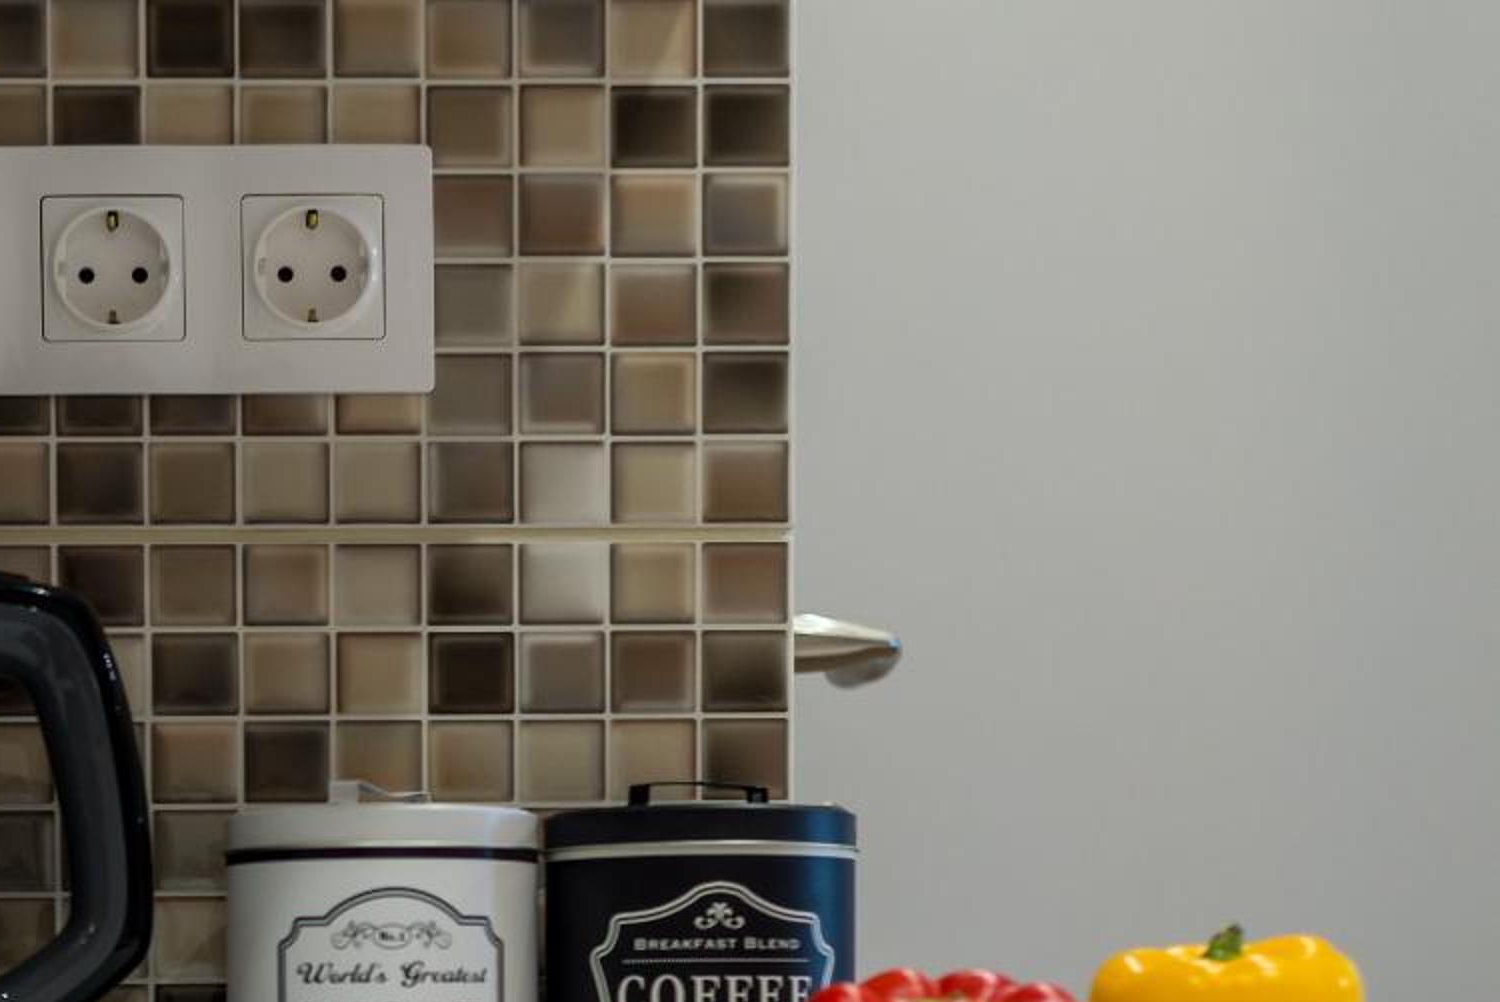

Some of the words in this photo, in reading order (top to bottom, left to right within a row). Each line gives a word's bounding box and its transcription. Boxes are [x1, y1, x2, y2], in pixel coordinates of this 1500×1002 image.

[633, 938, 737, 951] BREAKFAST
[743, 938, 801, 951] BLEND
[297, 961, 387, 985] World's
[400, 960, 488, 988] Greatest
